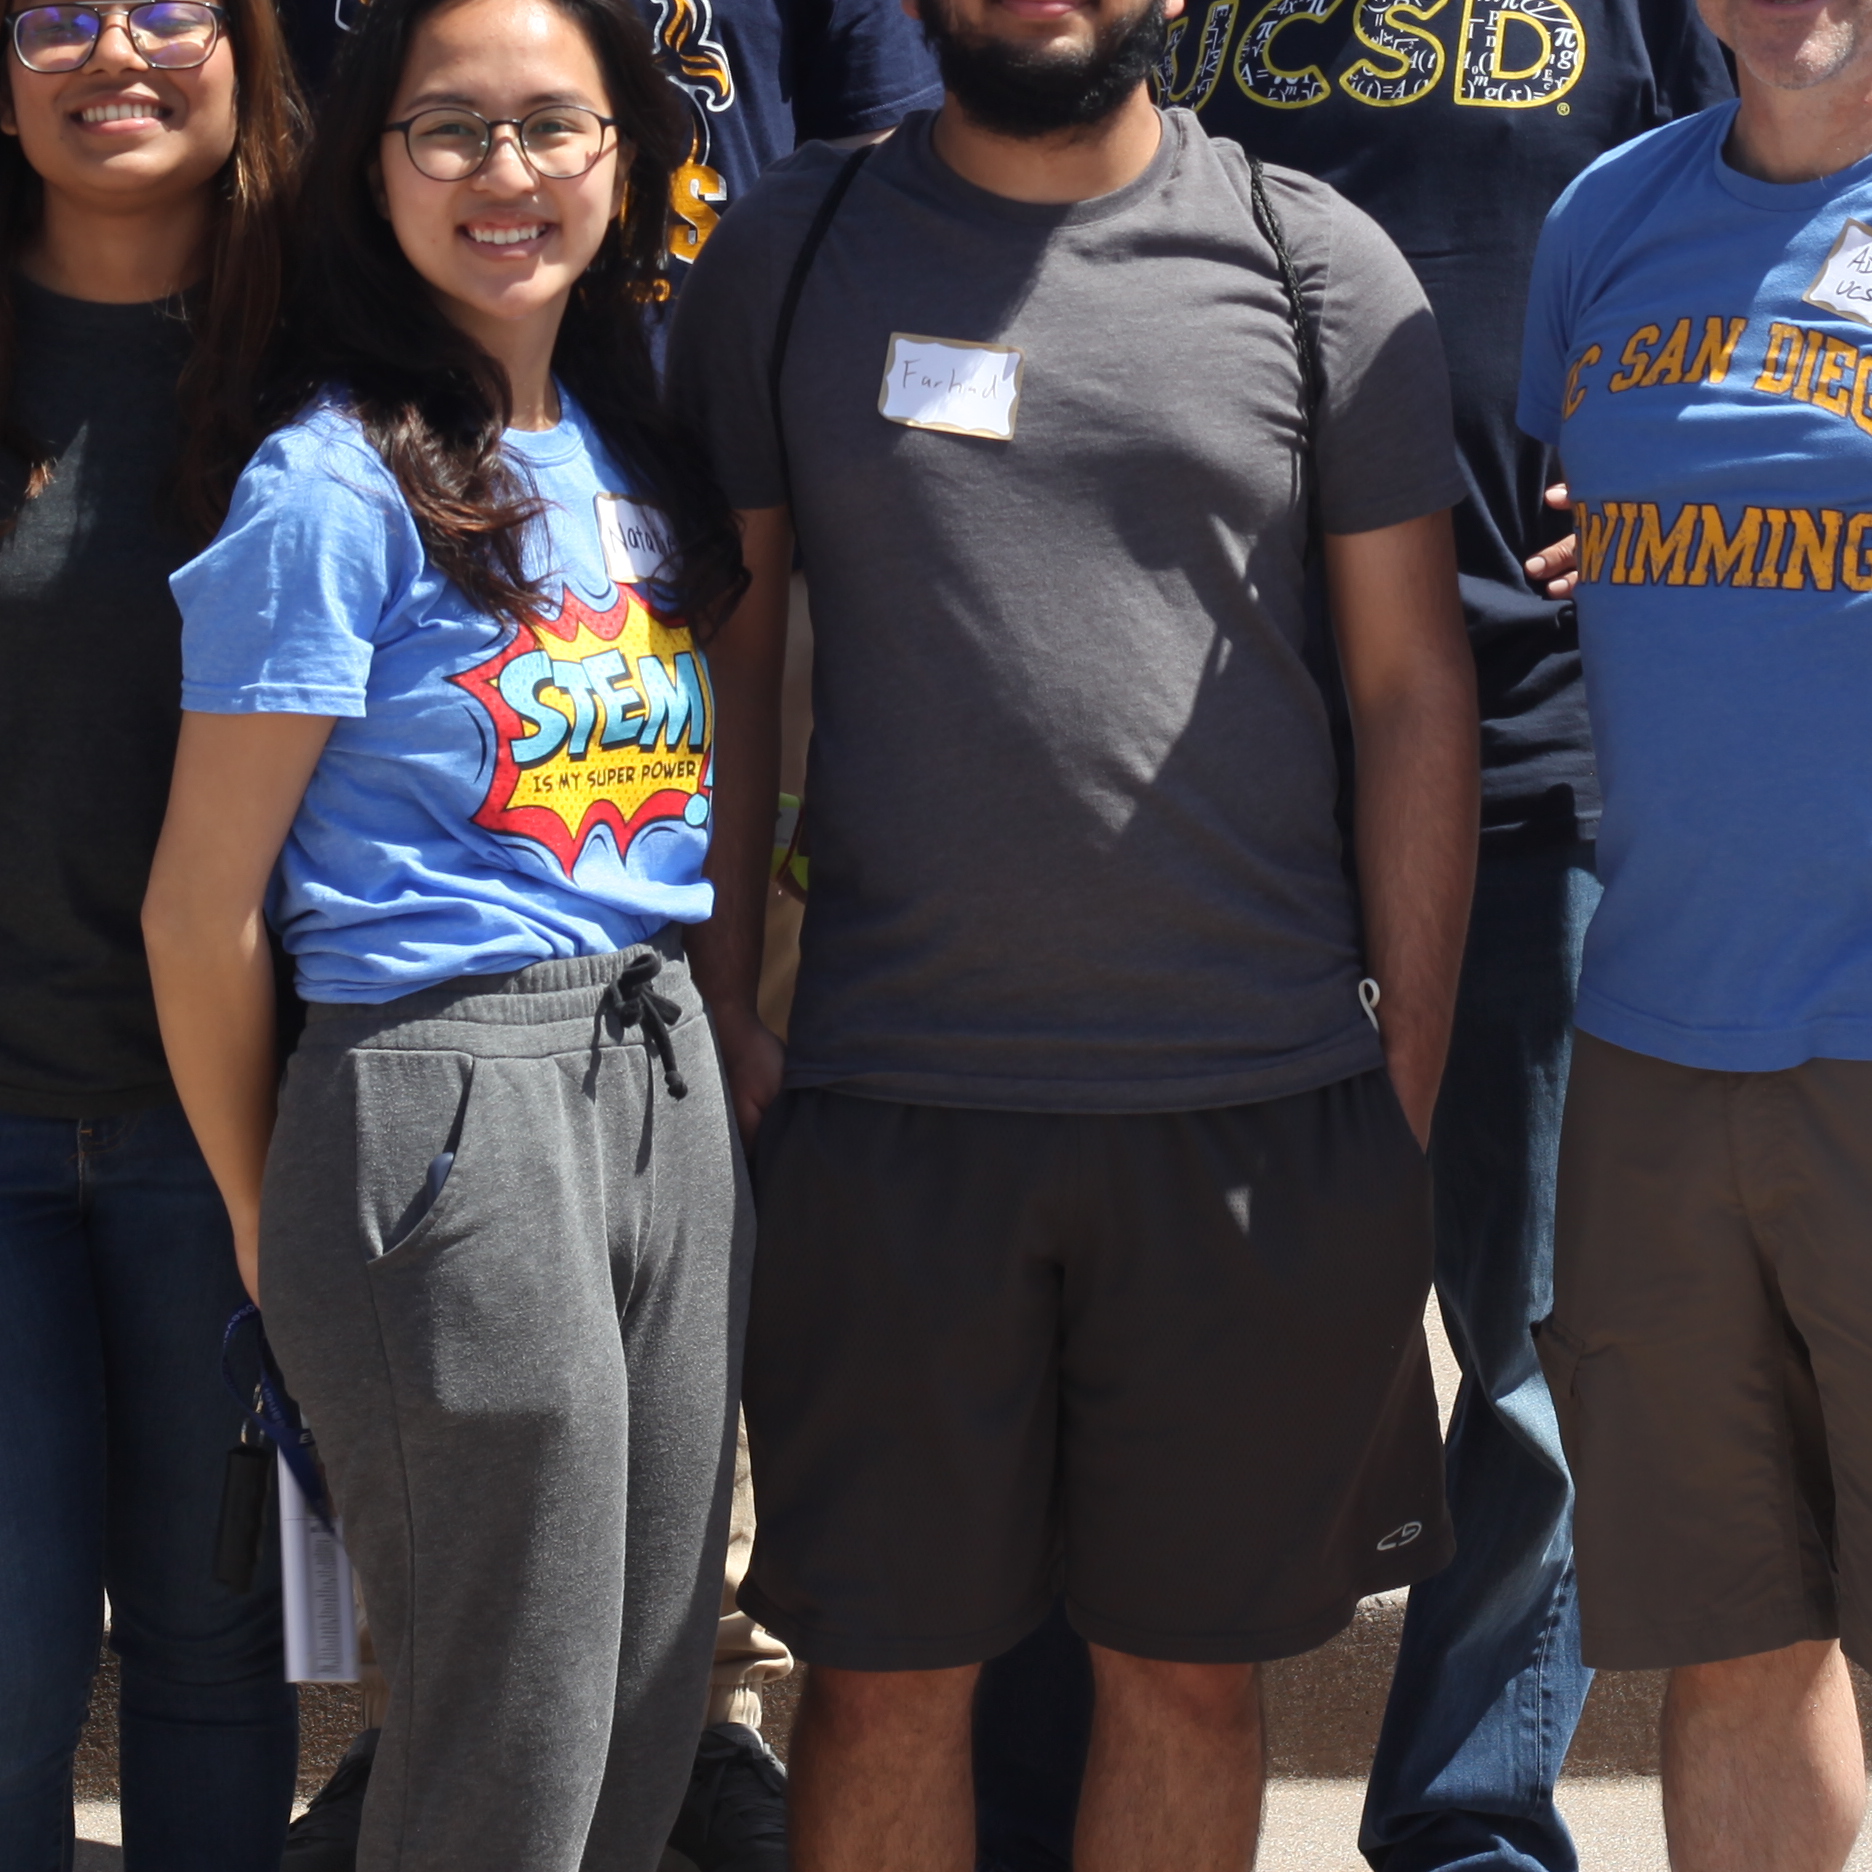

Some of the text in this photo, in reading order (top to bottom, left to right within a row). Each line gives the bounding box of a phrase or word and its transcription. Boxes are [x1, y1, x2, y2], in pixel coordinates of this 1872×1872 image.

[1562, 343, 1602, 420] C
[1608, 315, 1748, 394] SAN
[533, 760, 697, 793] IS MY SUPER POWER
